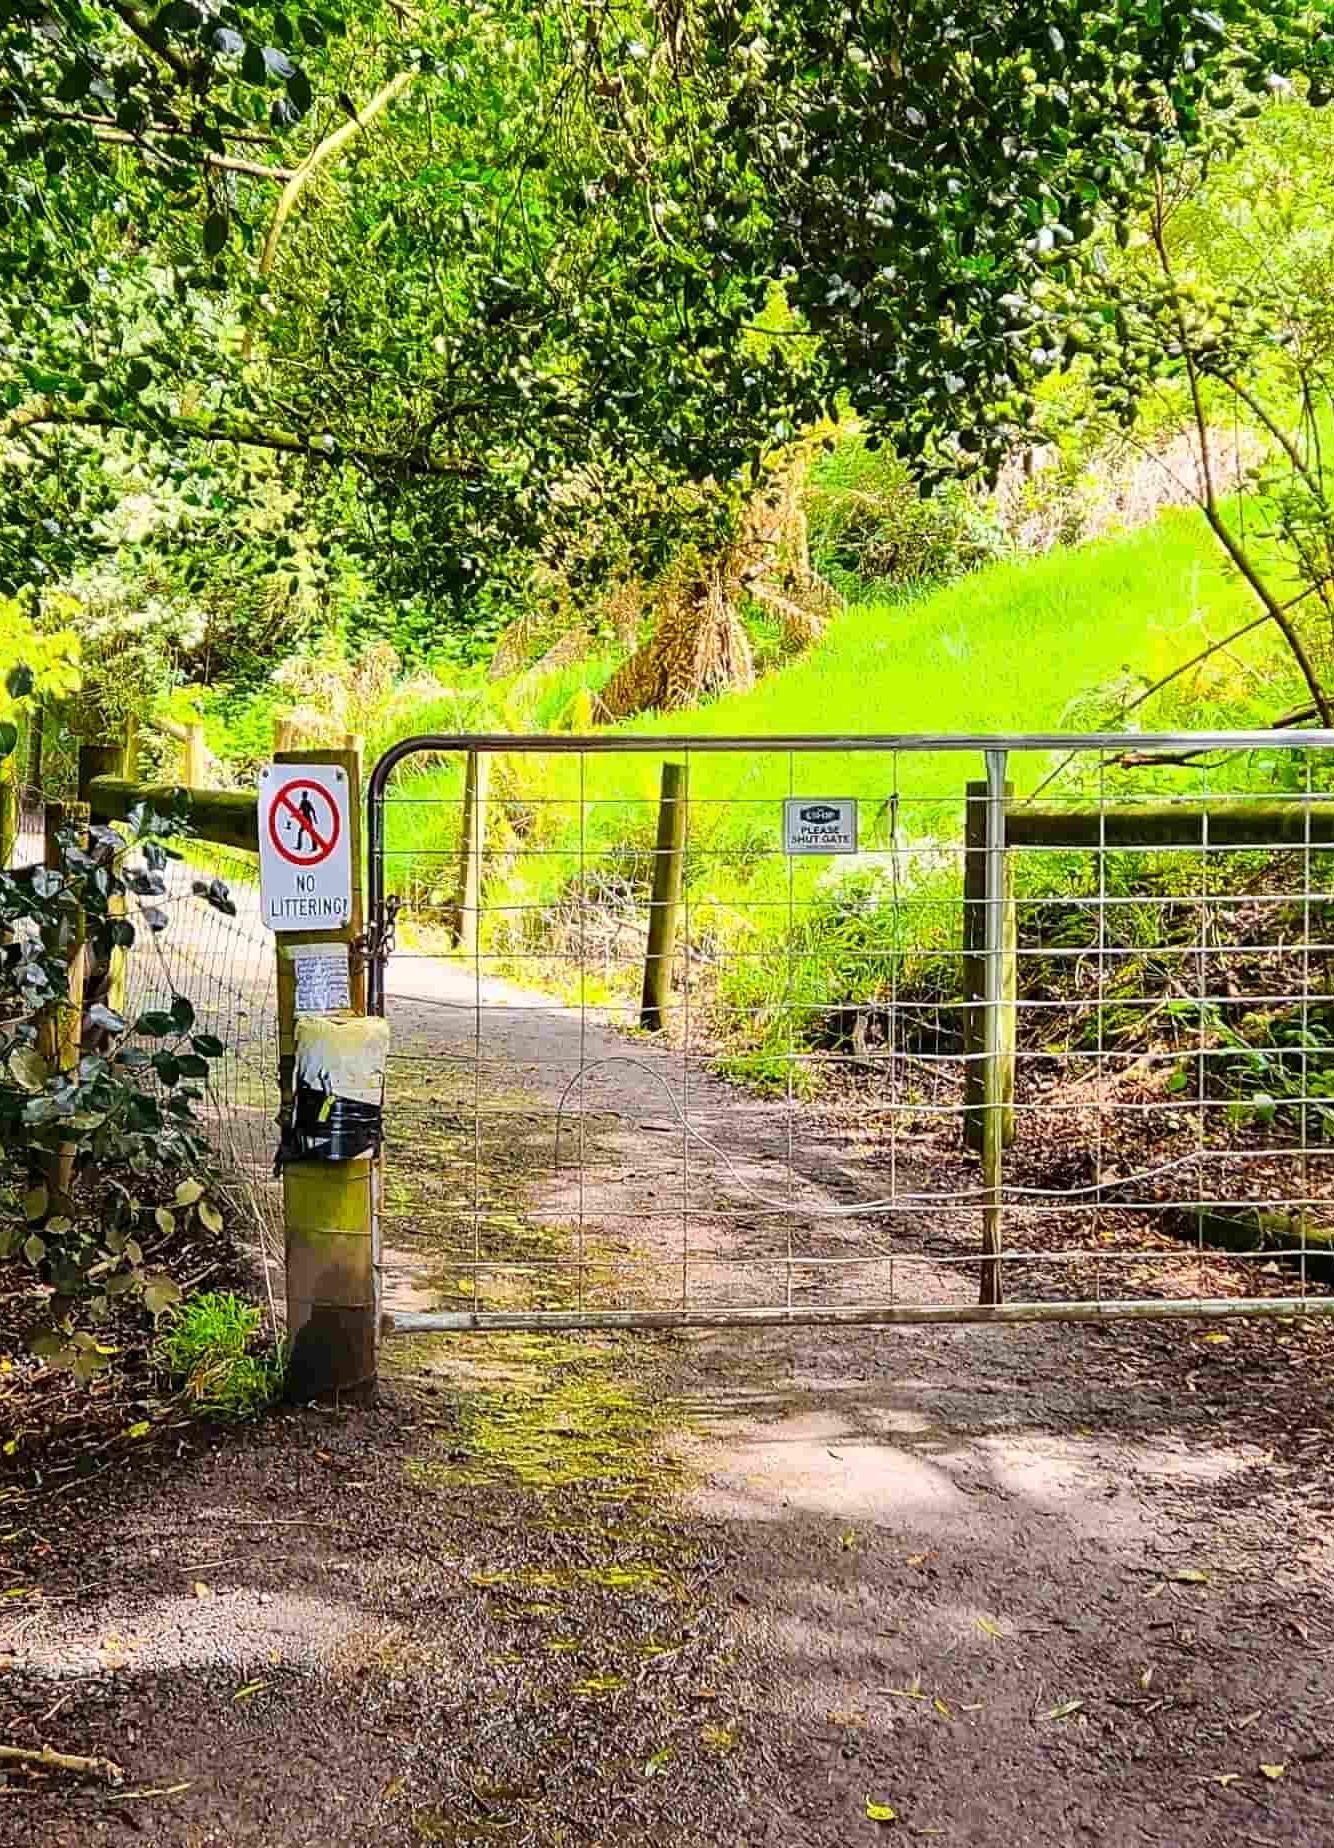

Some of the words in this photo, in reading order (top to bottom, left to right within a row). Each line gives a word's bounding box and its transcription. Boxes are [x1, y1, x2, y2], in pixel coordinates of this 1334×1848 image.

[821, 835, 849, 844] GATE
[296, 874, 315, 892] NO
[271, 898, 348, 917] LITTERING!
